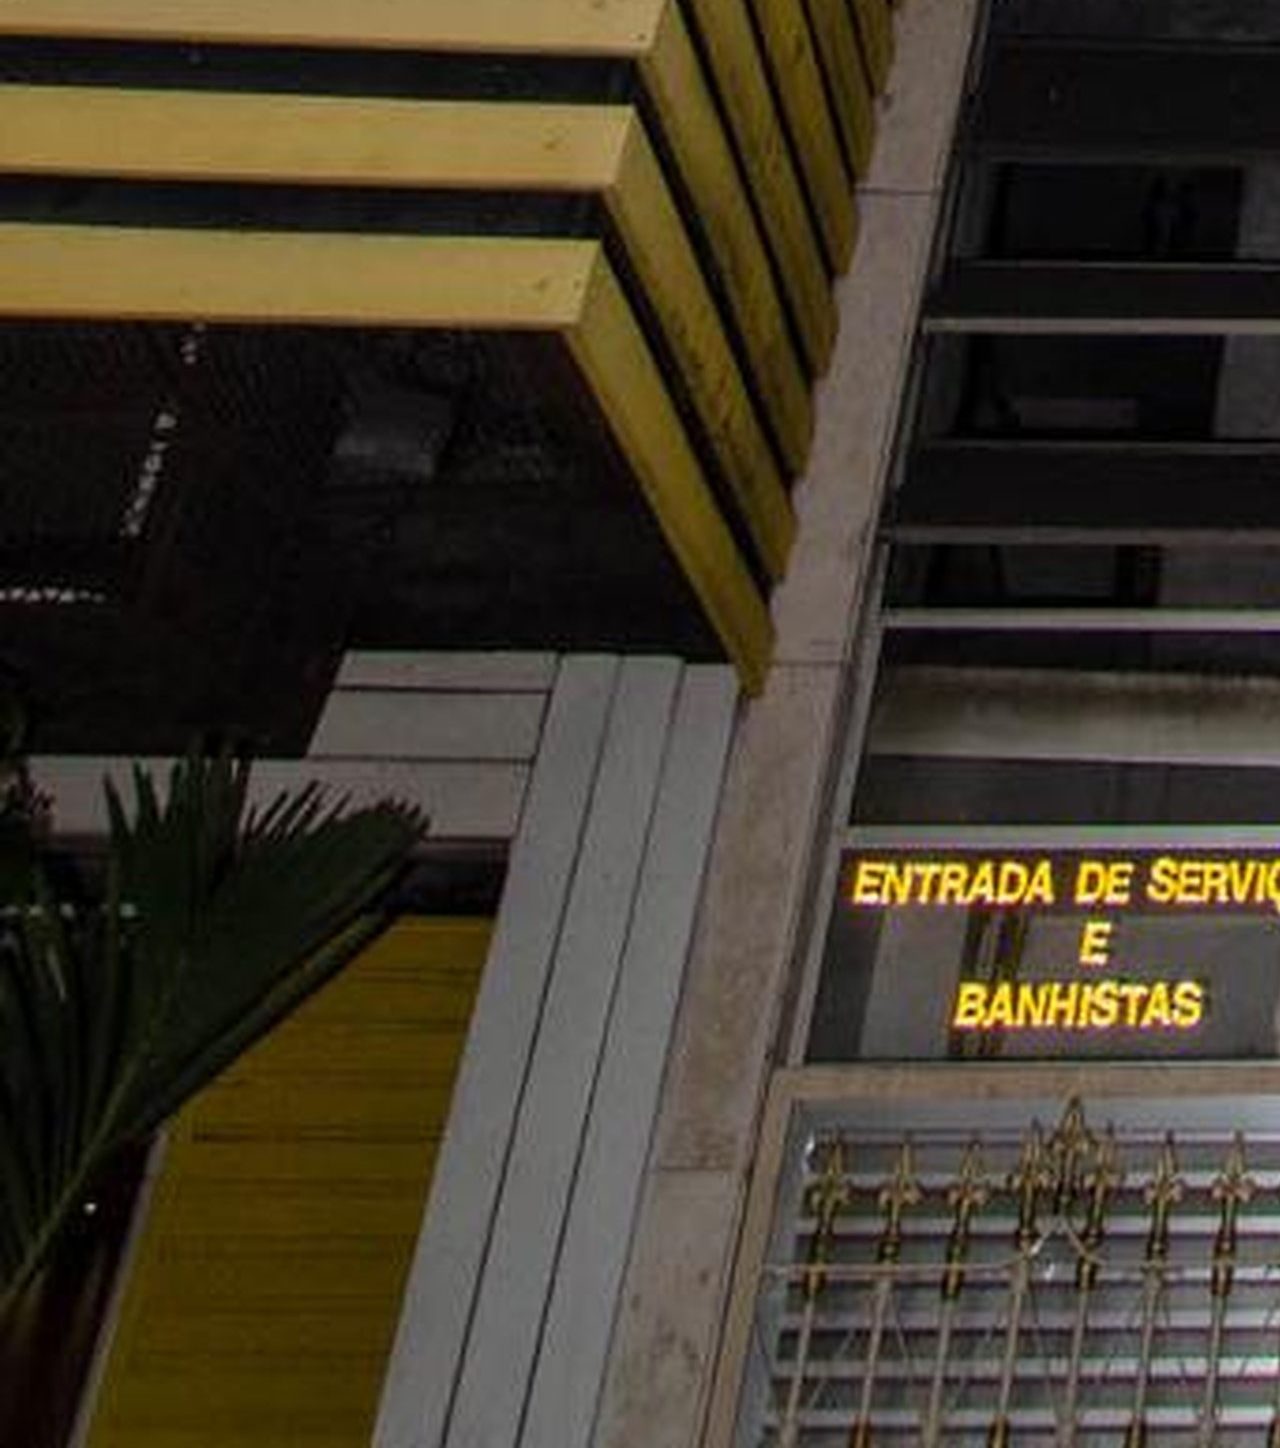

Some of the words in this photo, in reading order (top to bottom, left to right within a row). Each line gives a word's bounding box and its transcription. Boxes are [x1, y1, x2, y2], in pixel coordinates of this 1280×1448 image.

[853, 860, 1055, 906] ENTRADA
[1074, 860, 1131, 904] DE
[1079, 922, 1111, 966] E
[953, 981, 1203, 1029] BANHISTAS
